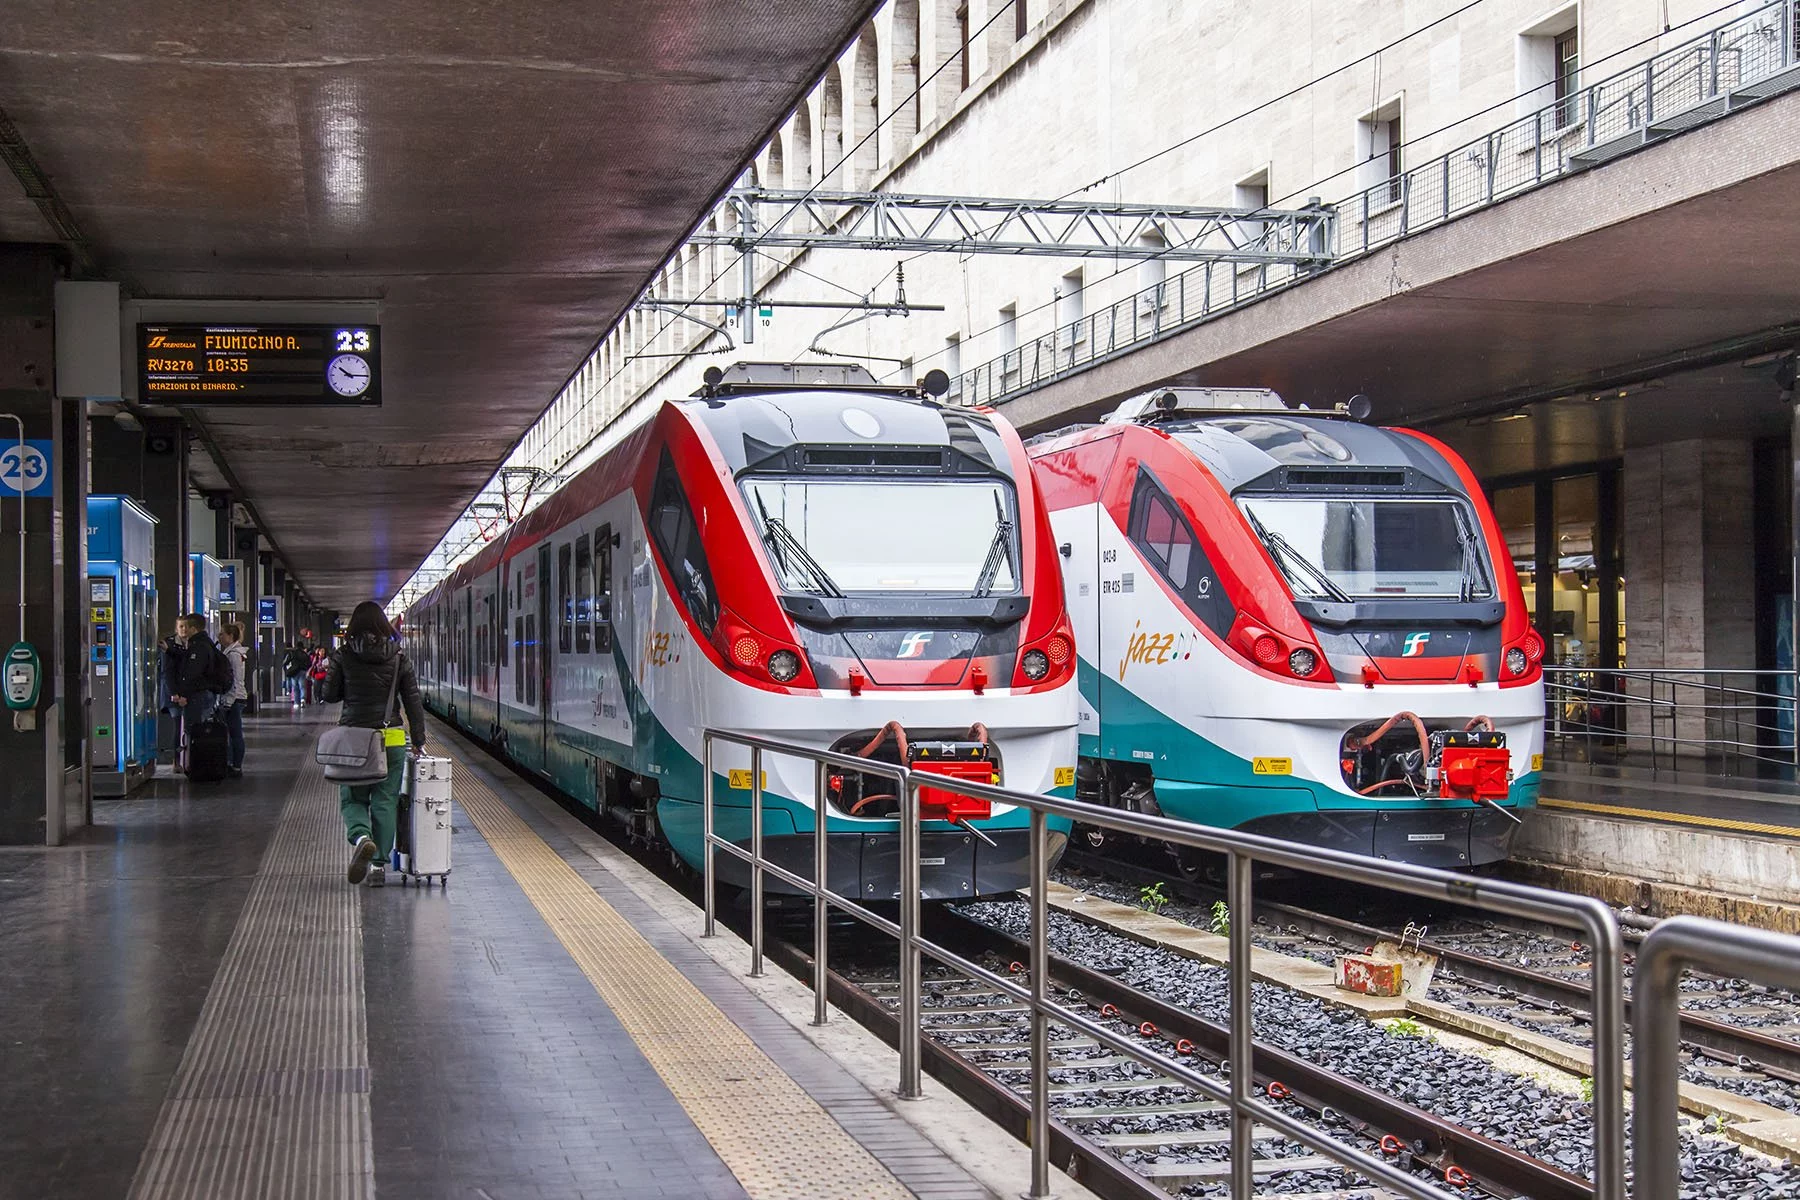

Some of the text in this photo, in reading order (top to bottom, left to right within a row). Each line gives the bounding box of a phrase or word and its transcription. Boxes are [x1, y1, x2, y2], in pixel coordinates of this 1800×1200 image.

[729, 318, 735, 327] 9
[762, 319, 771, 327] 10
[205, 335, 301, 350] FIUMICINO A.
[337, 331, 370, 351] 23
[147, 359, 194, 371] RV3270
[207, 359, 249, 372] 10:35
[190, 382, 200, 391] DI
[202, 382, 238, 391] BINARIO.
[2, 455, 43, 478] 23
[1119, 618, 1175, 682] jazz
